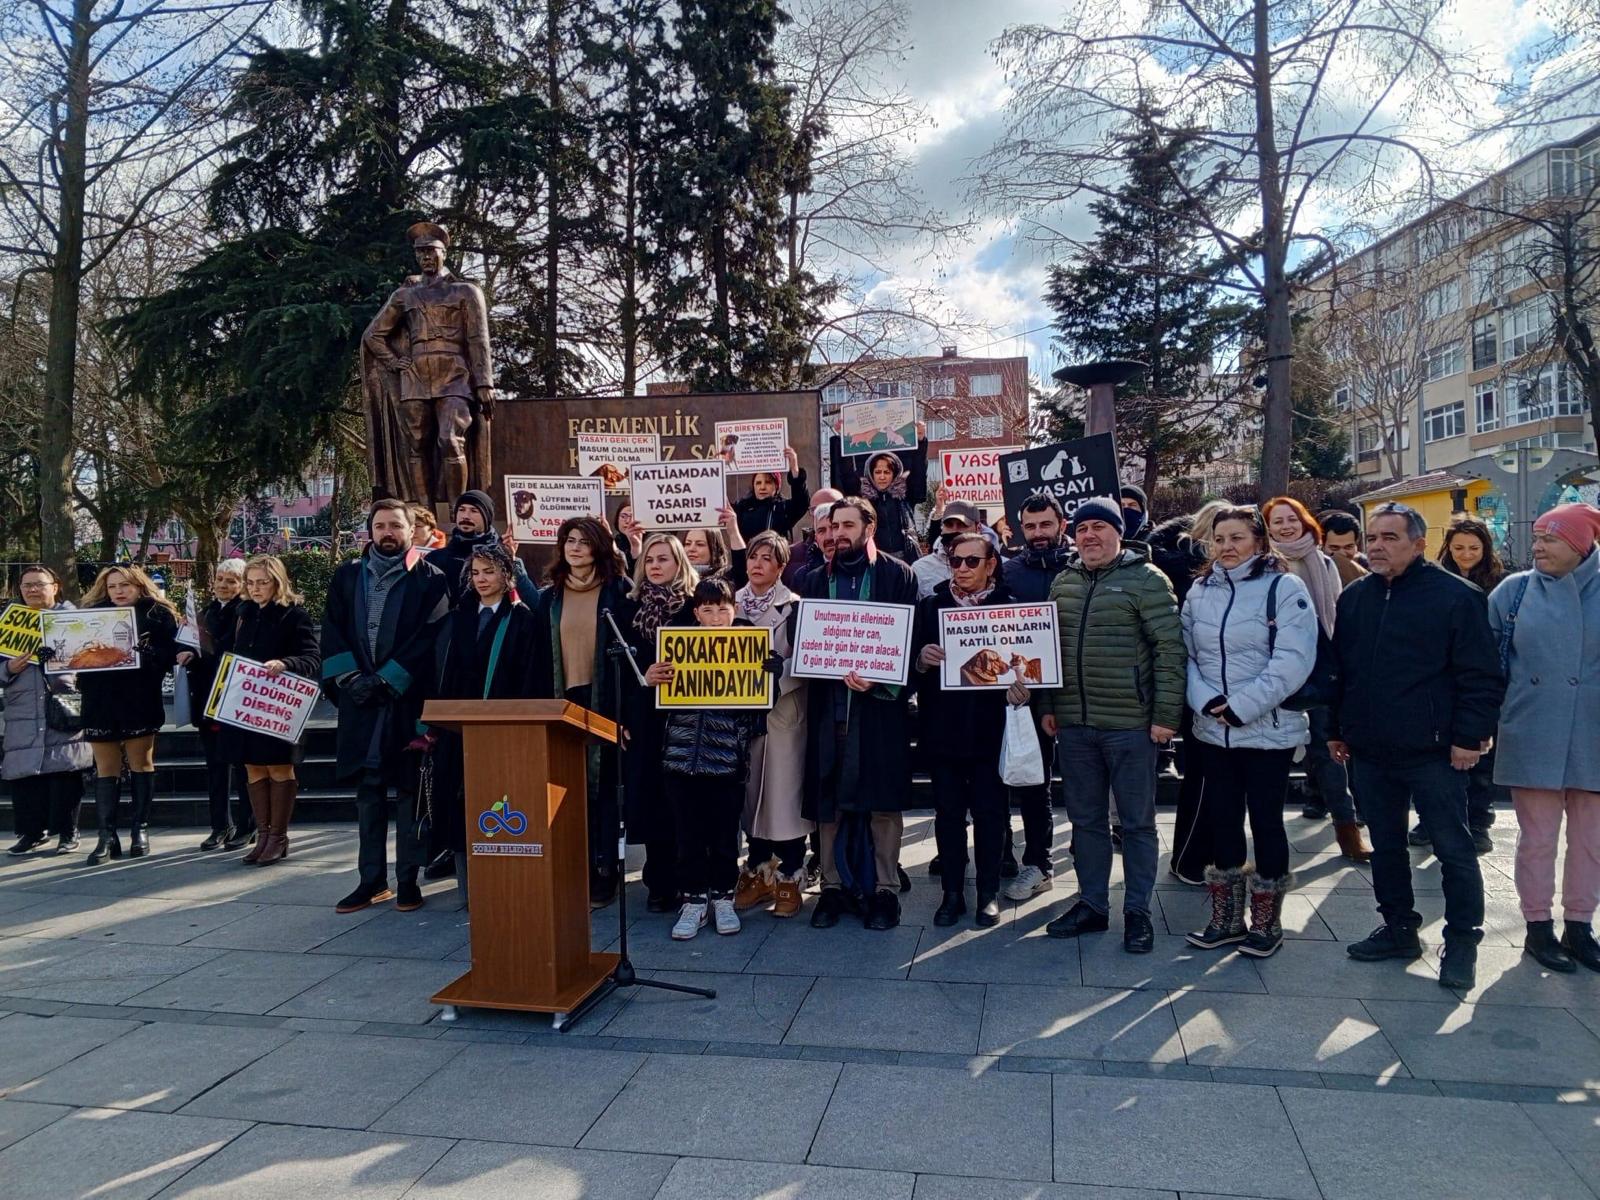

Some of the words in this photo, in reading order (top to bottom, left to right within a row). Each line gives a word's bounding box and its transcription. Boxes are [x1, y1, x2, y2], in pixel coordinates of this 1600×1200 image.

[568, 409, 699, 438] EGEMENLİK
[634, 466, 720, 480] KATLİAMDAN
[955, 472, 1003, 487] KANL
[657, 483, 692, 494] YASA
[540, 503, 591, 511] ÖLDÜRMEYİN
[648, 497, 707, 509] TASARISI
[655, 513, 702, 524] OLMAZ
[5, 609, 42, 632] SOKA
[814, 610, 851, 624] Unutmayın
[852, 612, 860, 621] ki
[860, 613, 895, 626] ellerinizle
[946, 612, 985, 621] YASAYI
[1019, 607, 1042, 619] ÇEK
[822, 626, 852, 639] aldığınız
[853, 628, 865, 638] her
[866, 631, 882, 641] can,
[946, 624, 988, 635] MASUM
[991, 622, 1051, 633] CANLARIN
[801, 639, 823, 650] sizden
[823, 641, 833, 651] bir
[834, 643, 848, 654] gün
[849, 643, 860, 653] bir
[860, 646, 874, 654] can
[875, 645, 902, 657] alacak.
[959, 635, 997, 647] KATİLİ
[1000, 635, 1033, 645] OLMA
[664, 636, 767, 664] SOKAKTAYIM
[803, 654, 809, 665] O
[809, 655, 823, 668] gün
[823, 656, 838, 669] güç
[838, 659, 853, 668] ama
[855, 660, 868, 671] geç
[869, 659, 897, 672] olacak.
[242, 679, 303, 709] ÖLDÜRÜR
[234, 709, 291, 734] YAŞATIR
